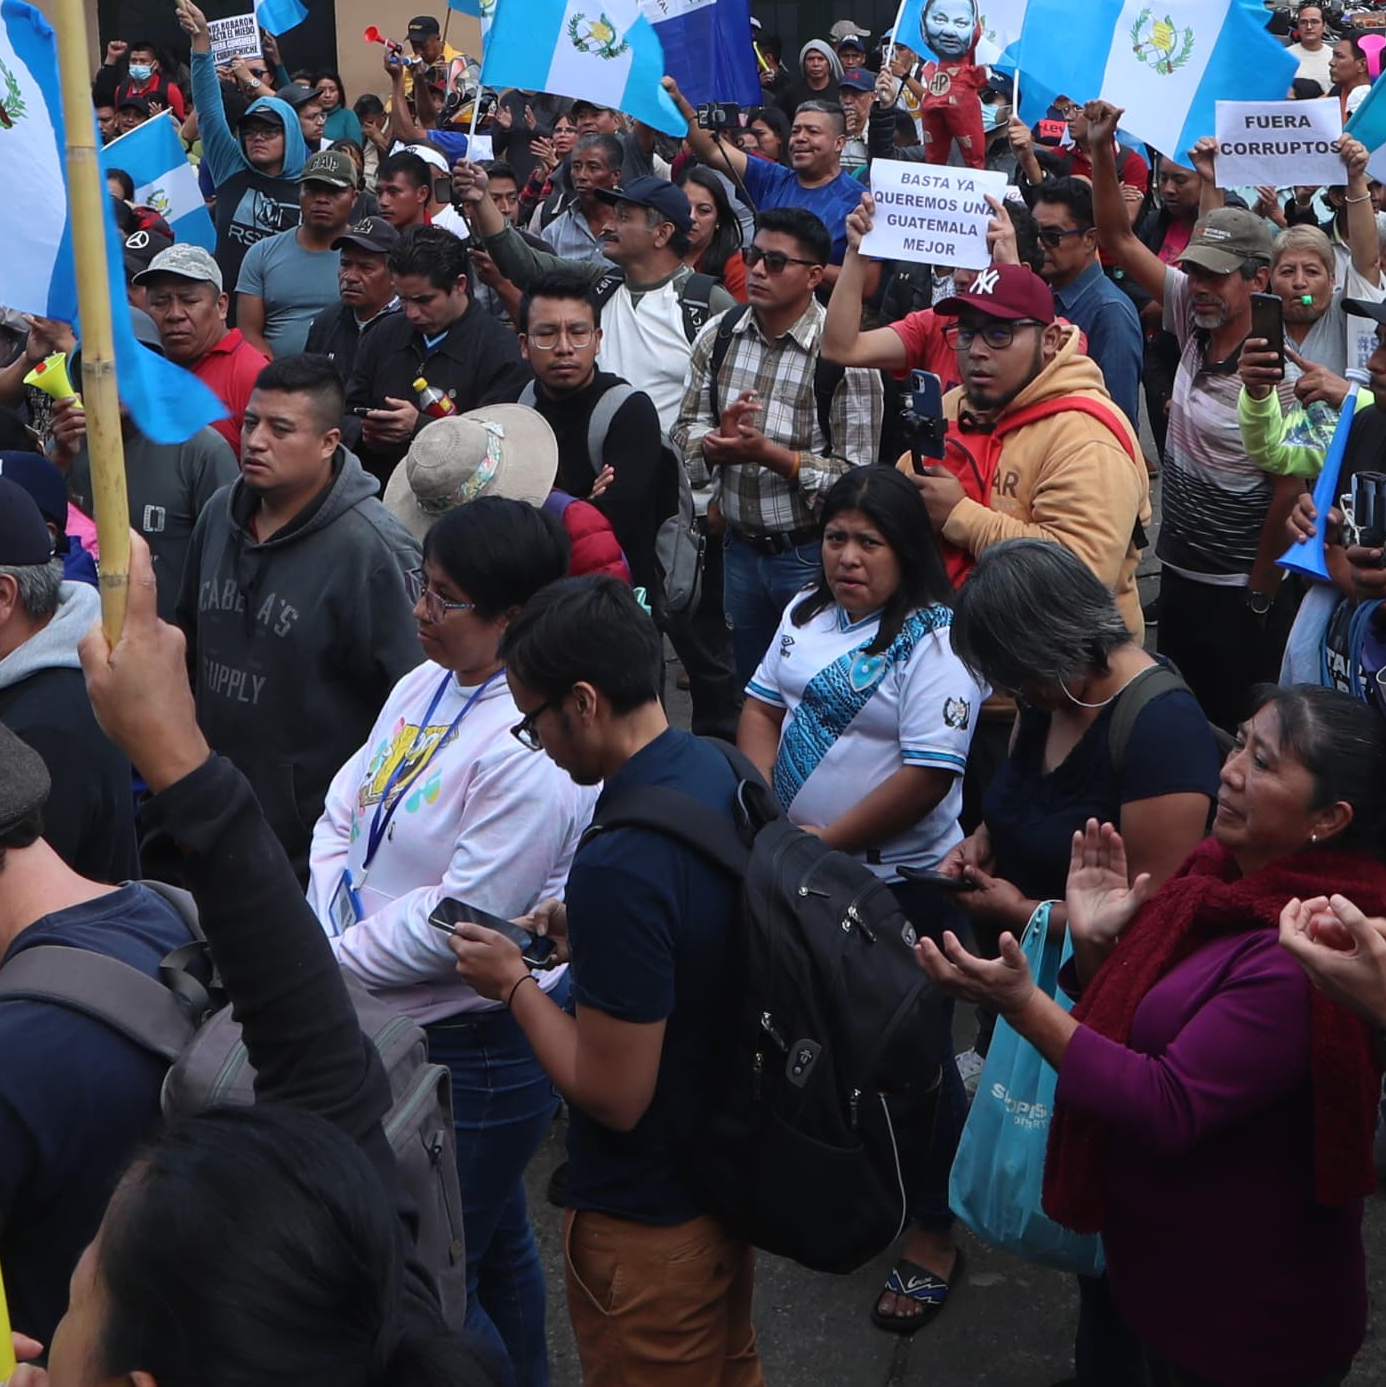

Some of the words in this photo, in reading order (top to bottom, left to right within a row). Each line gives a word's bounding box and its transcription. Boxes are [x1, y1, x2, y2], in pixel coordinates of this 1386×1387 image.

[930, 73, 949, 92] HP
[1244, 115, 1312, 129] FUERA
[1220, 141, 1342, 156] CORRUPTOS
[900, 172, 950, 189] BASTA
[956, 179, 976, 192] YA
[874, 190, 958, 212] QUEREMOS
[962, 201, 998, 217] UNA
[887, 213, 979, 237] GUATEMALA
[903, 237, 956, 256] MEJOR
